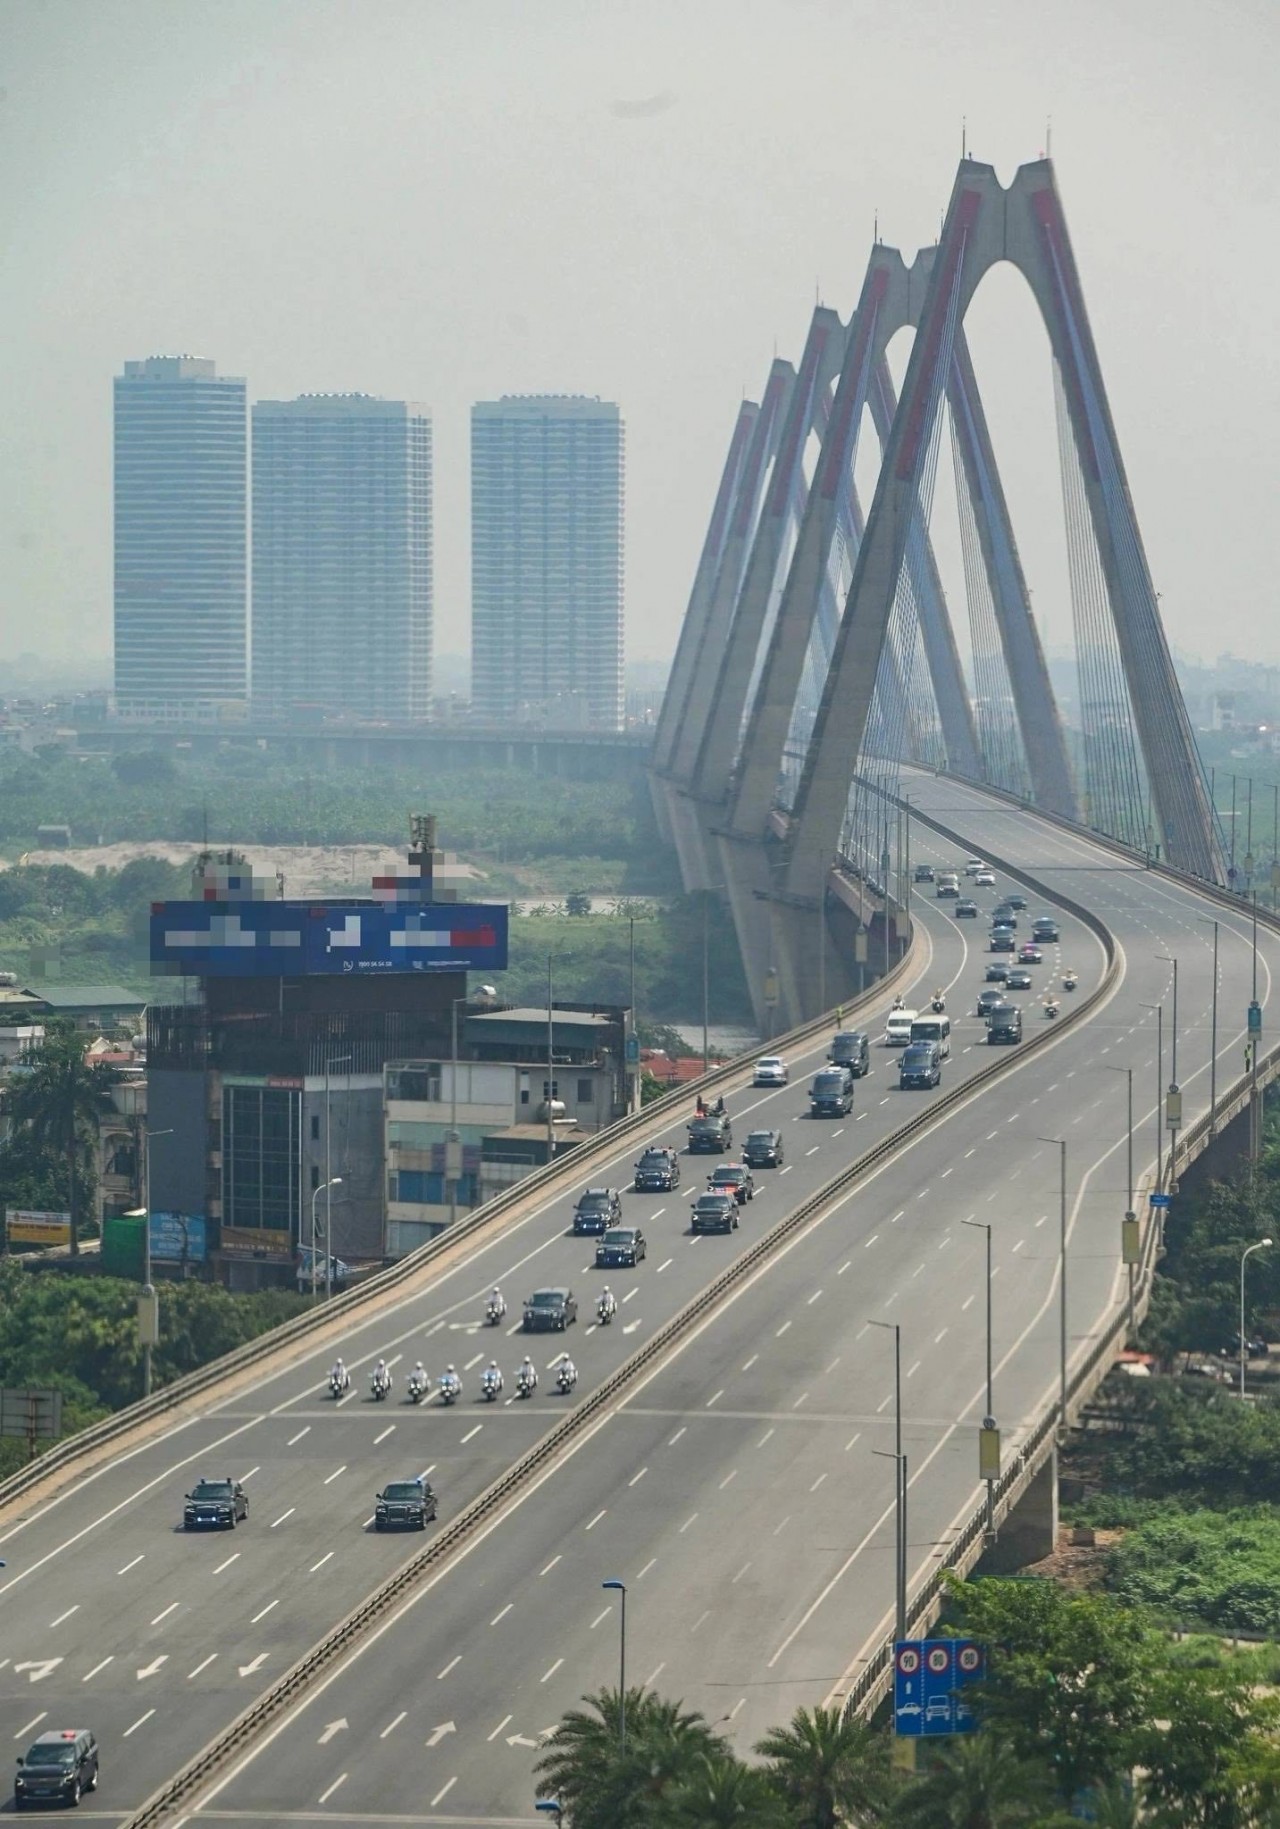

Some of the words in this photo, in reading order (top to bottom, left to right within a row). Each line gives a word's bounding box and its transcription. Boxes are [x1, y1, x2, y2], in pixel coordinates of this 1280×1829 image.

[903, 1655, 914, 1668] 90
[933, 1653, 944, 1666] 80
[964, 1652, 975, 1665] 80
